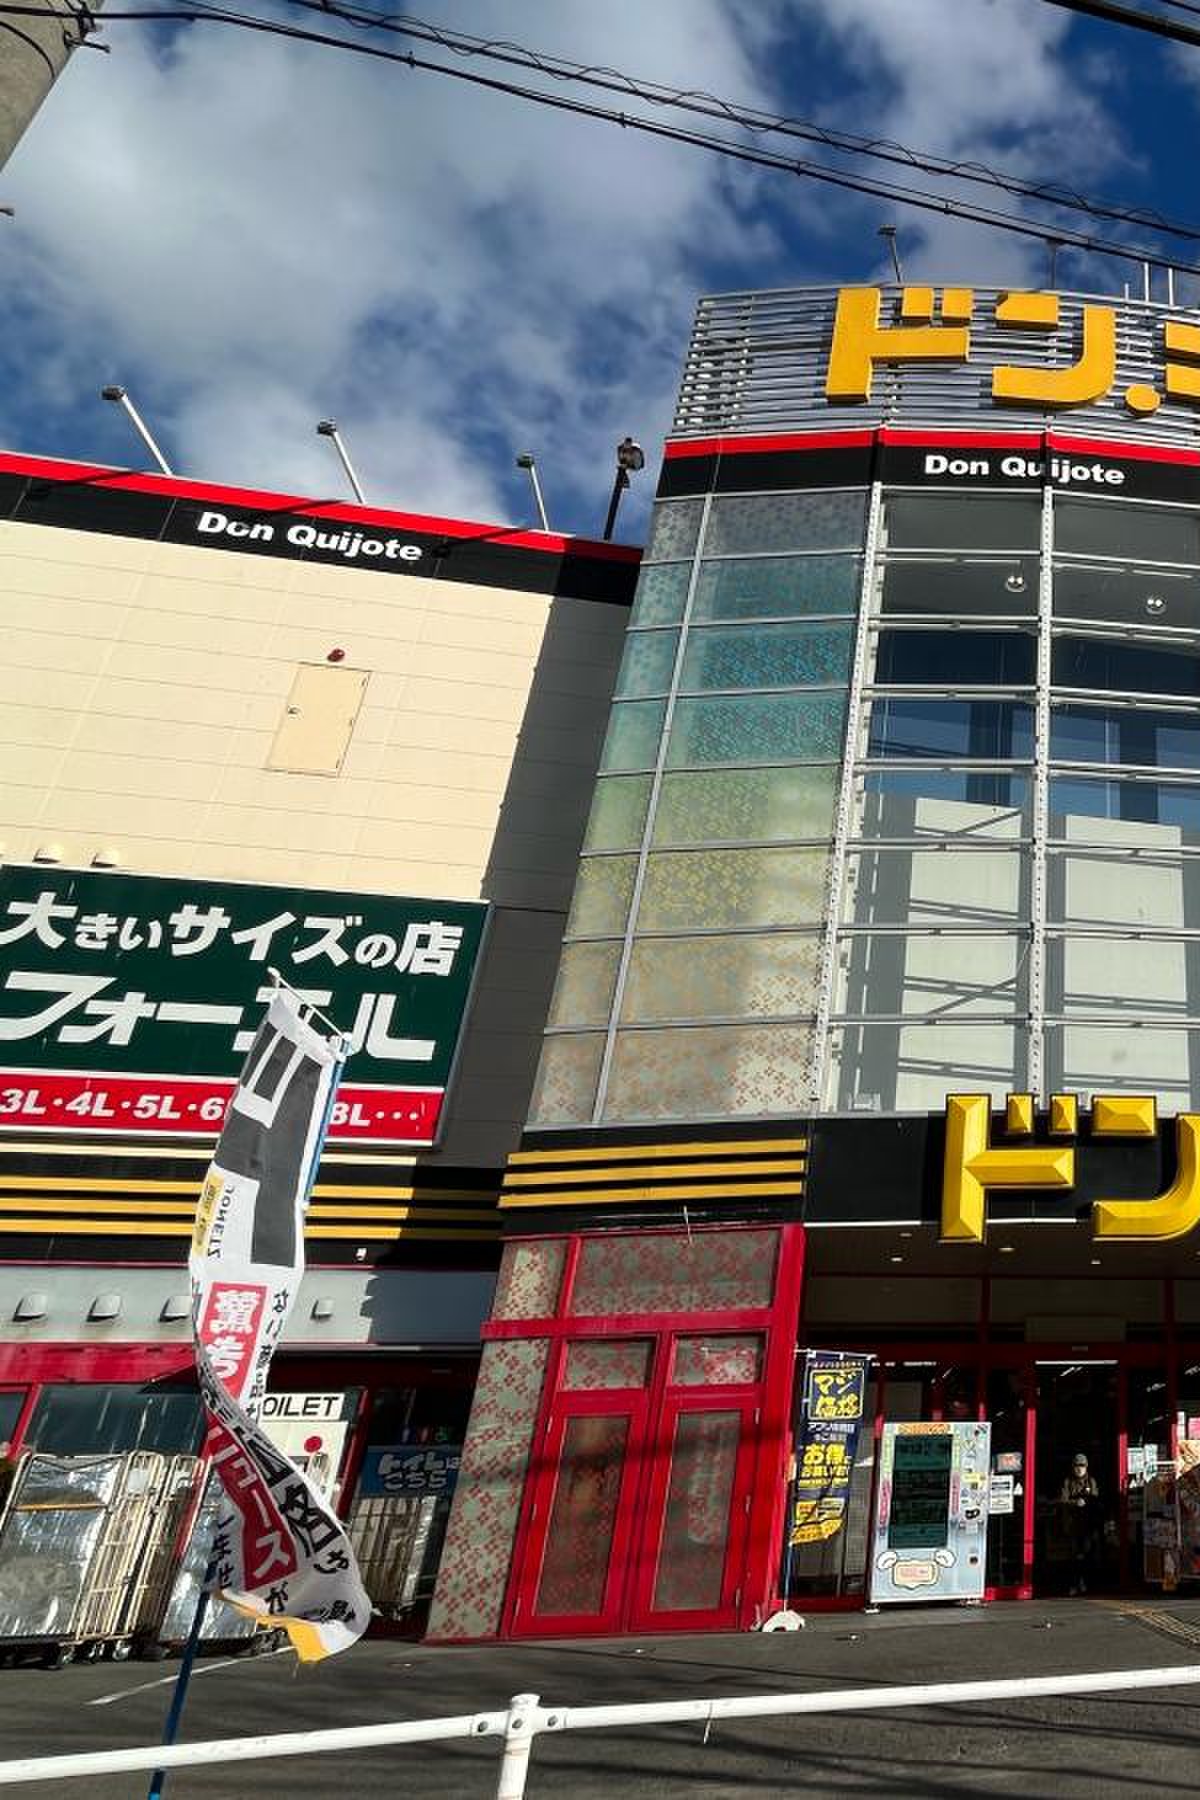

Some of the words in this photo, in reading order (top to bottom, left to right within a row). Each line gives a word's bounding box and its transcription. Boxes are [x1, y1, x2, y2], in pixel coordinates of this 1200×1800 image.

[924, 455, 990, 476] Don
[1001, 456, 1125, 485] Quijote
[197, 511, 274, 541] Don
[287, 525, 422, 560] Quijote
[0, 891, 465, 977] 大きいサイズの店
[262, 1395, 341, 1418] OILET
